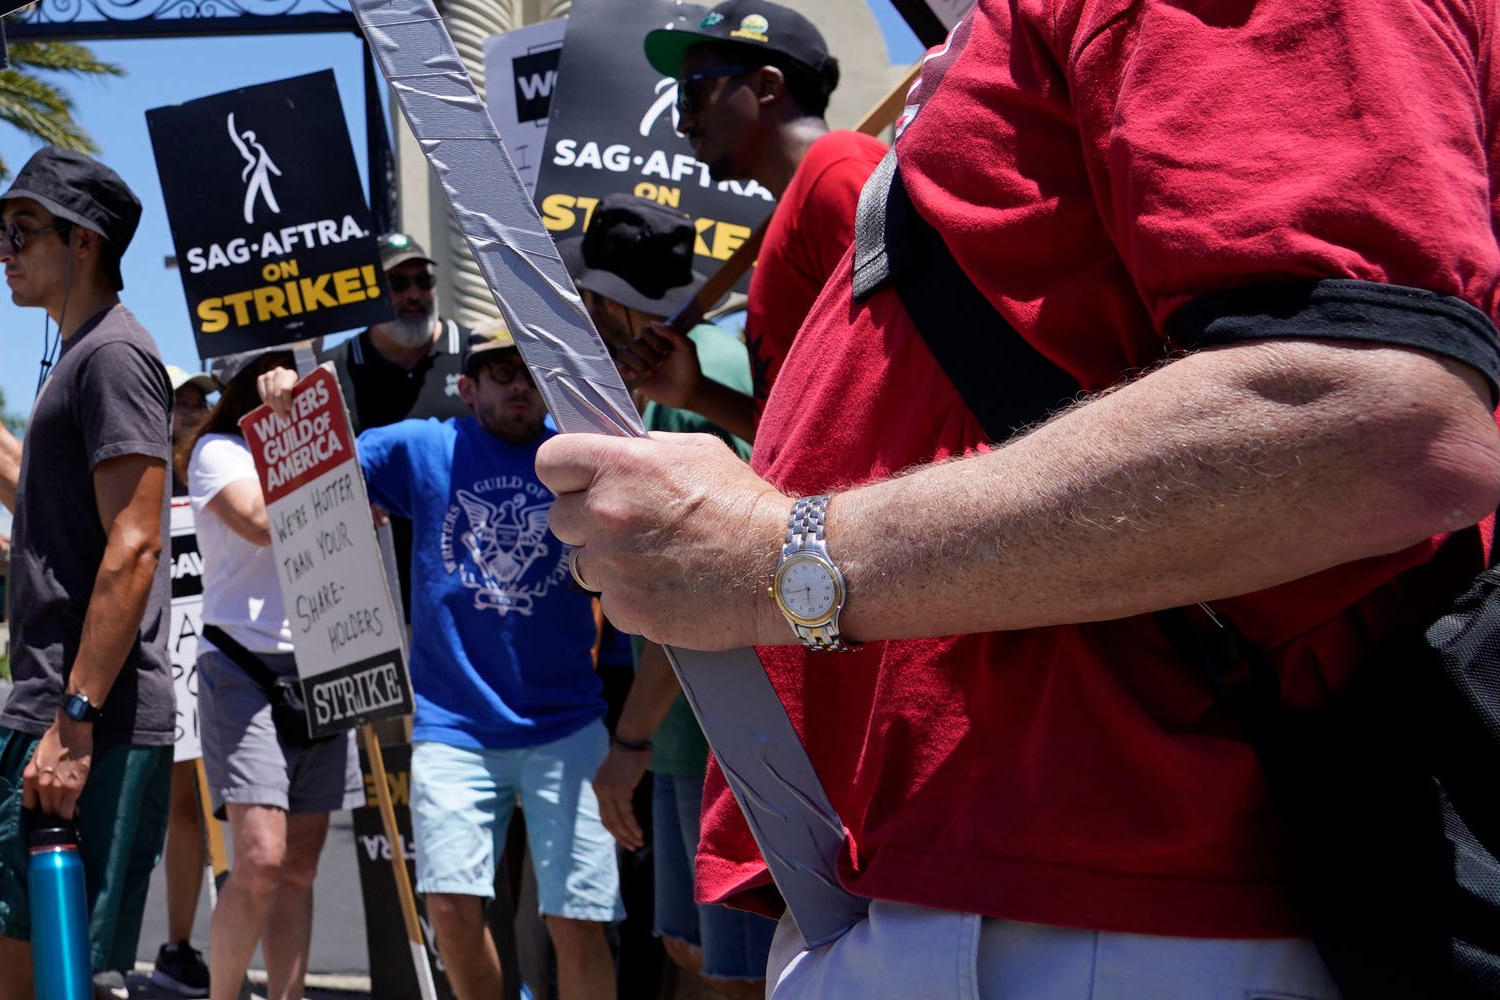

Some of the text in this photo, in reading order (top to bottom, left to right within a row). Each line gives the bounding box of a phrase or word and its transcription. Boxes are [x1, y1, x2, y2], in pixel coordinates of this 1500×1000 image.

[633, 182, 681, 208] ON
[262, 259, 299, 282] ON
[197, 264, 381, 333] STRIKE!
[263, 411, 331, 465] GUILD OF
[266, 429, 343, 492] AMERICA
[316, 521, 354, 561] YOUR
[441, 504, 461, 574] WRITERS
[473, 475, 523, 494] GUILD
[327, 607, 384, 655] HOLDERS
[312, 662, 403, 725] STRIKE
